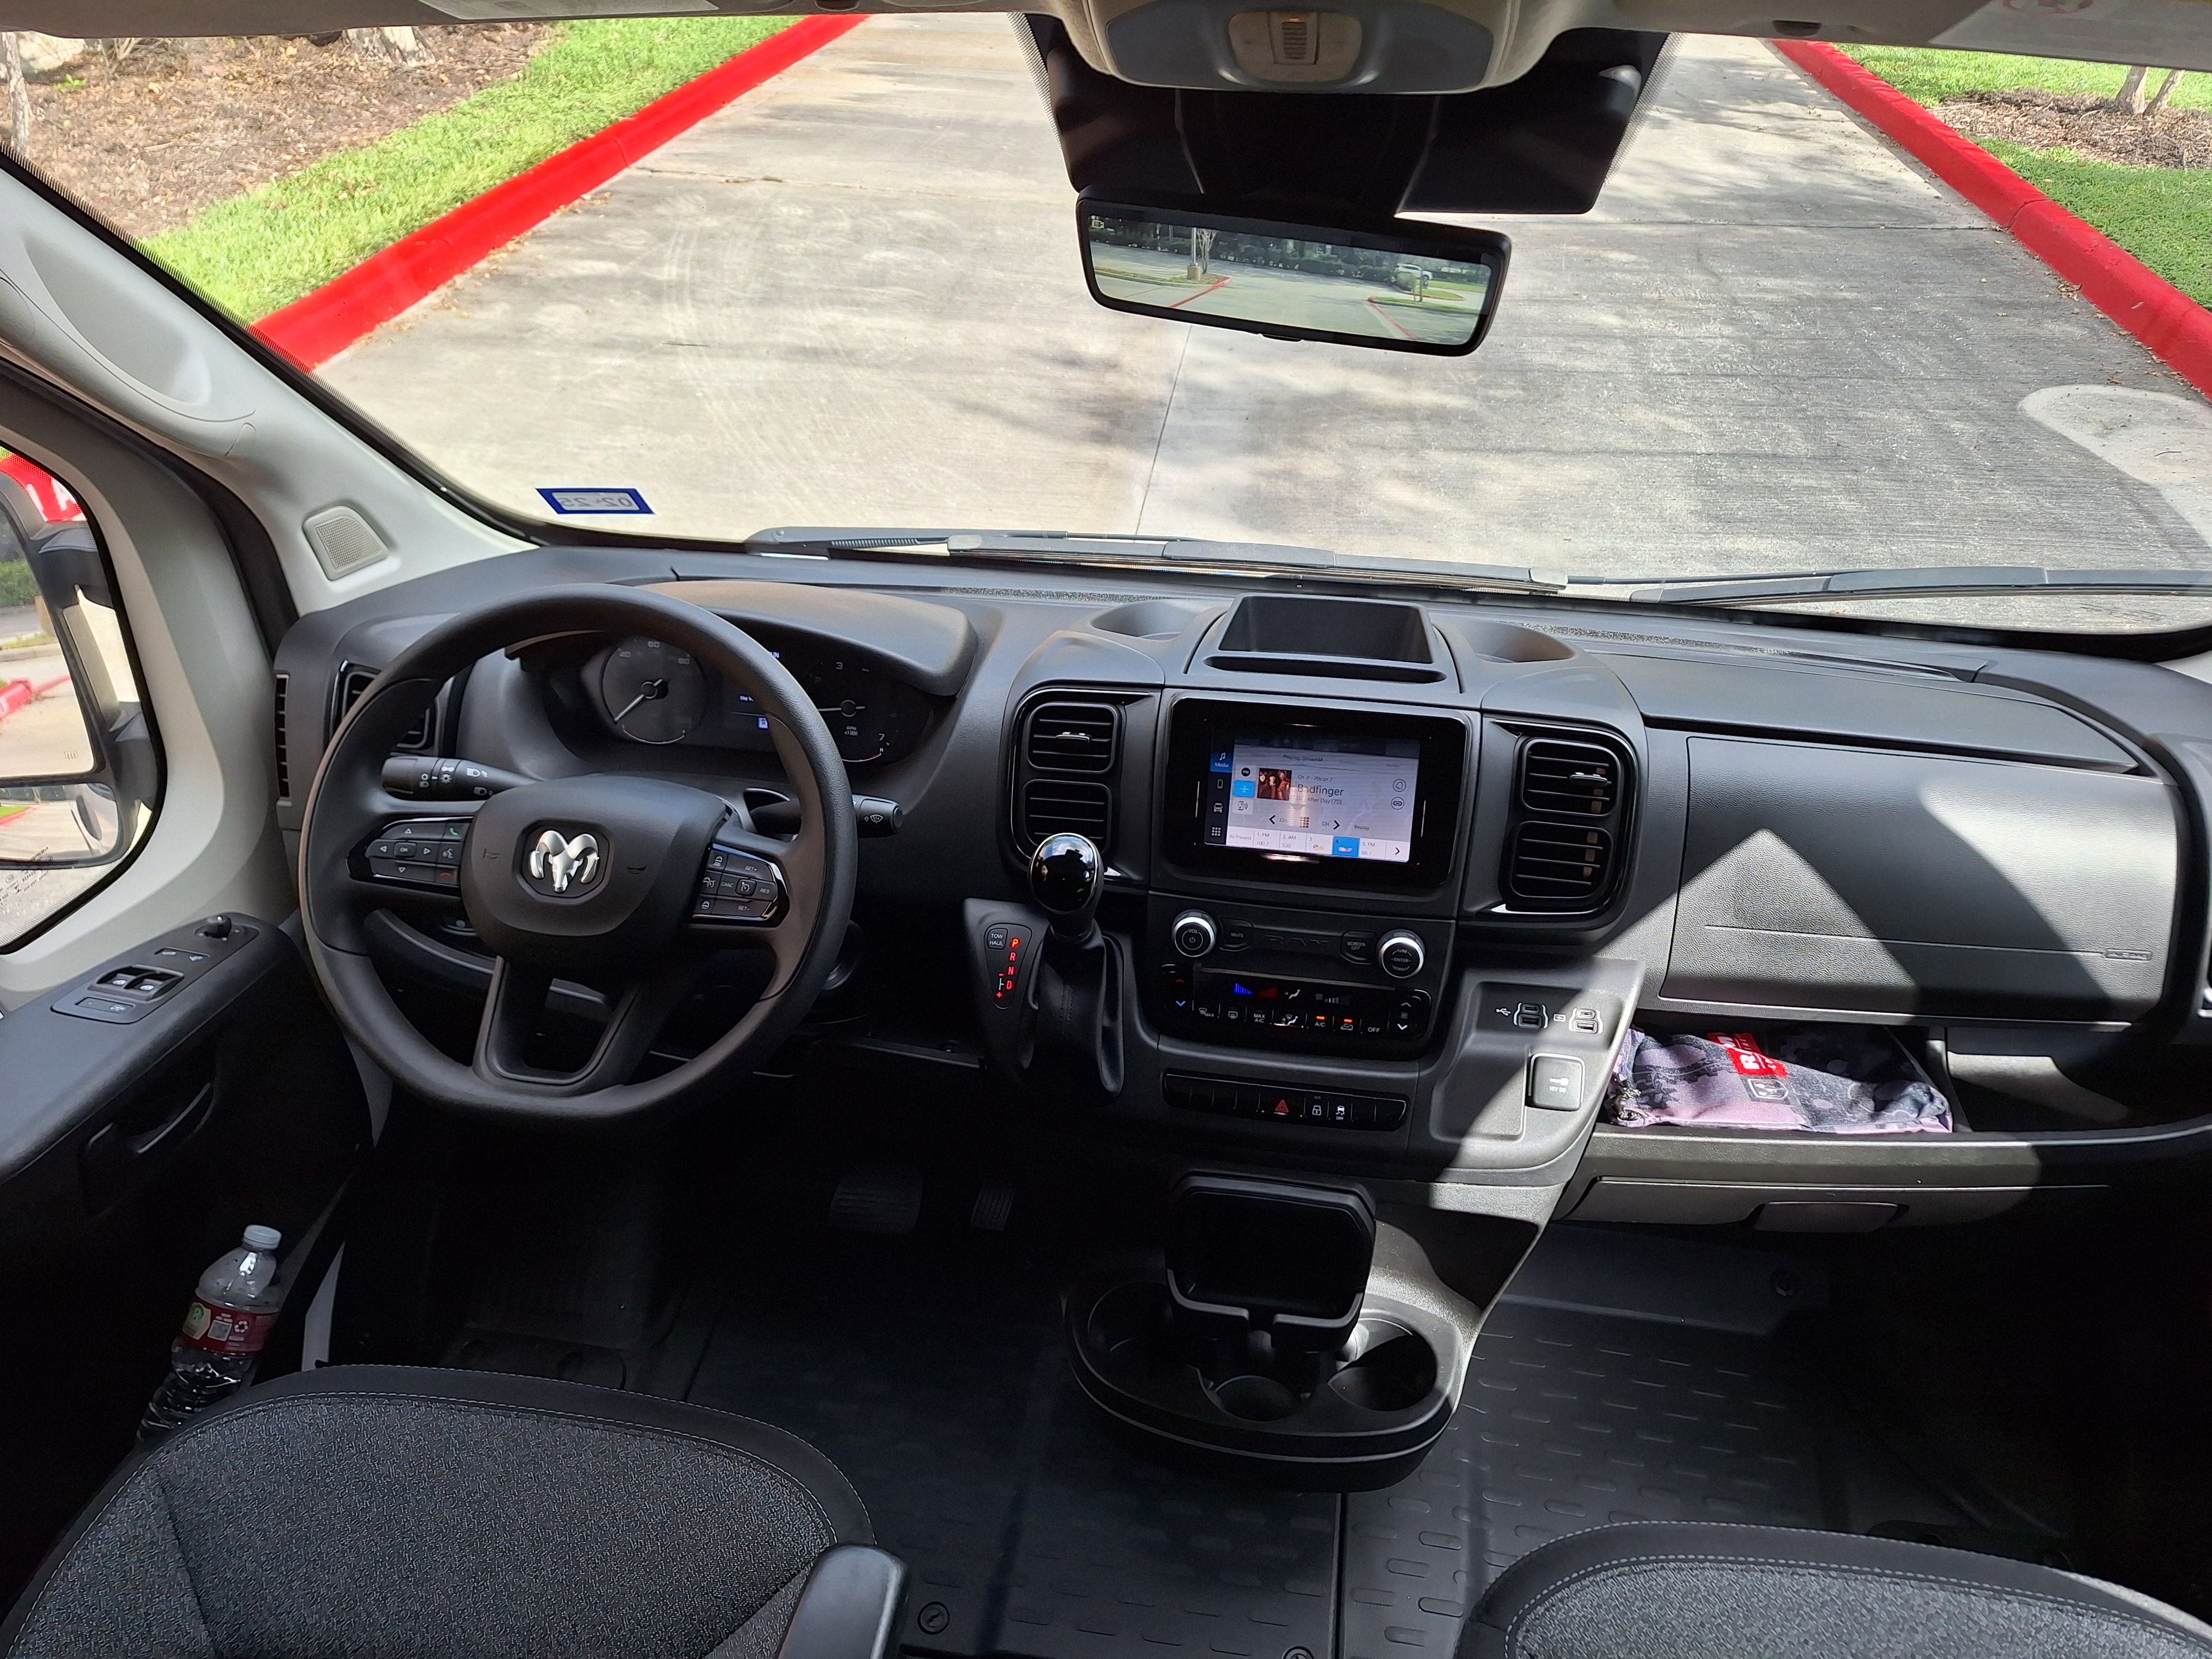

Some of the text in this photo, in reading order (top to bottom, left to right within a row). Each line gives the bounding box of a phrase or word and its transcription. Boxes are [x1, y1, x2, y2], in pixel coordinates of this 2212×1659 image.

[835, 661, 843, 670] 3
[878, 733, 885, 741] 7
[1297, 783, 1345, 798] Badfinger
[1012, 938, 1018, 947] P
[1009, 953, 1016, 961] R
[1008, 966, 1014, 975] N
[1006, 980, 1012, 989] D
